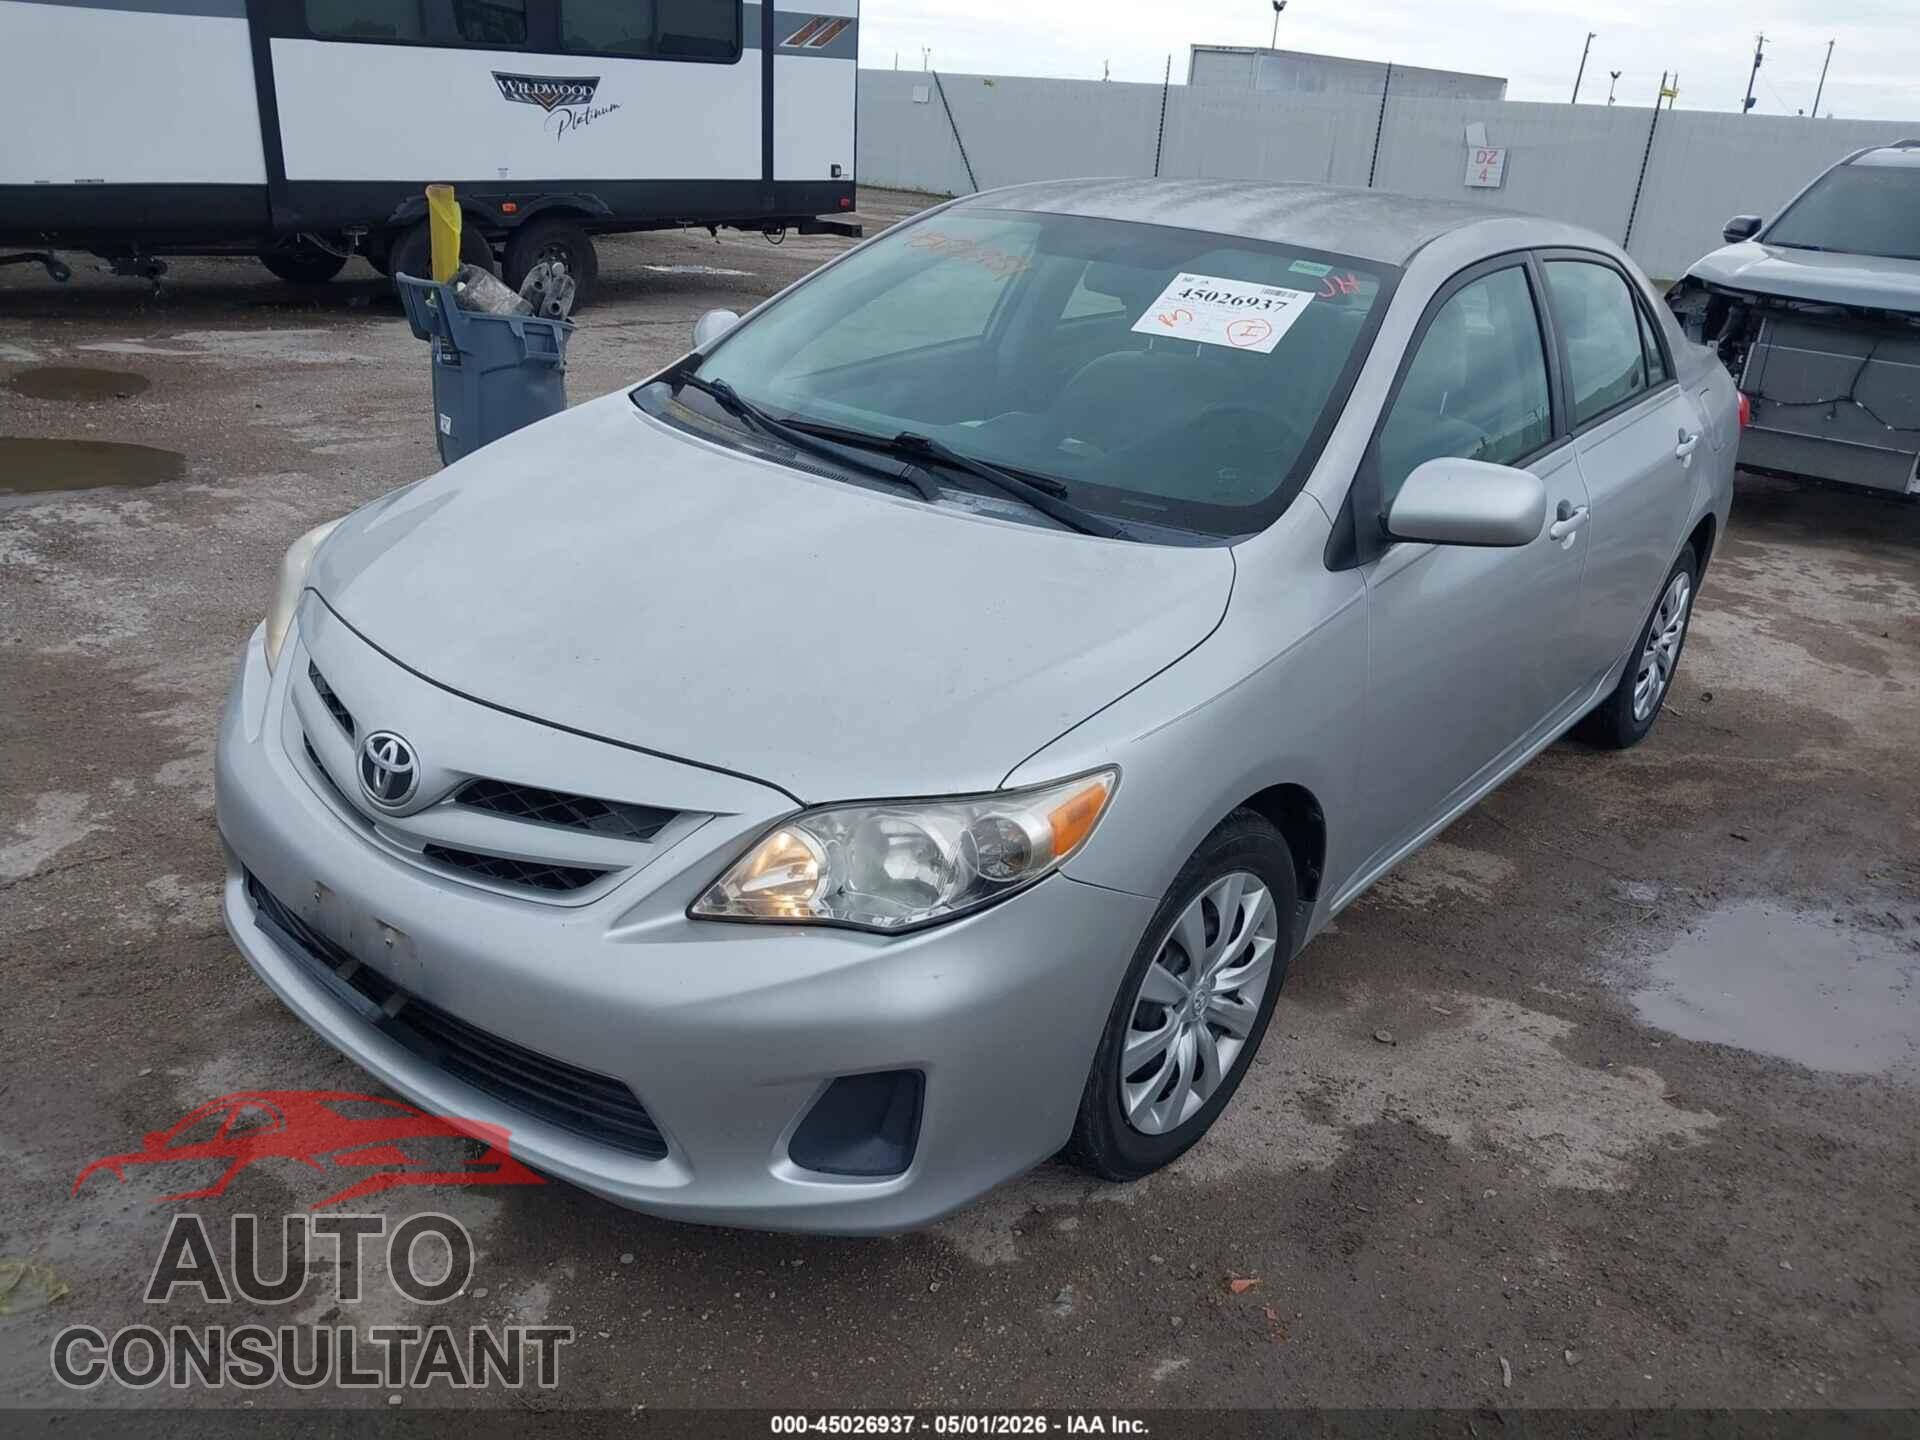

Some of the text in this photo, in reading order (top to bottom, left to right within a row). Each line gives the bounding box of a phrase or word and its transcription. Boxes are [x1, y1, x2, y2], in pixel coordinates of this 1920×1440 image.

[498, 79, 595, 97] WILDWOOD
[544, 103, 622, 144] Platinum
[1475, 149, 1498, 165] DZ
[1479, 167, 1488, 183] 4
[1178, 287, 1290, 314] 45026937
